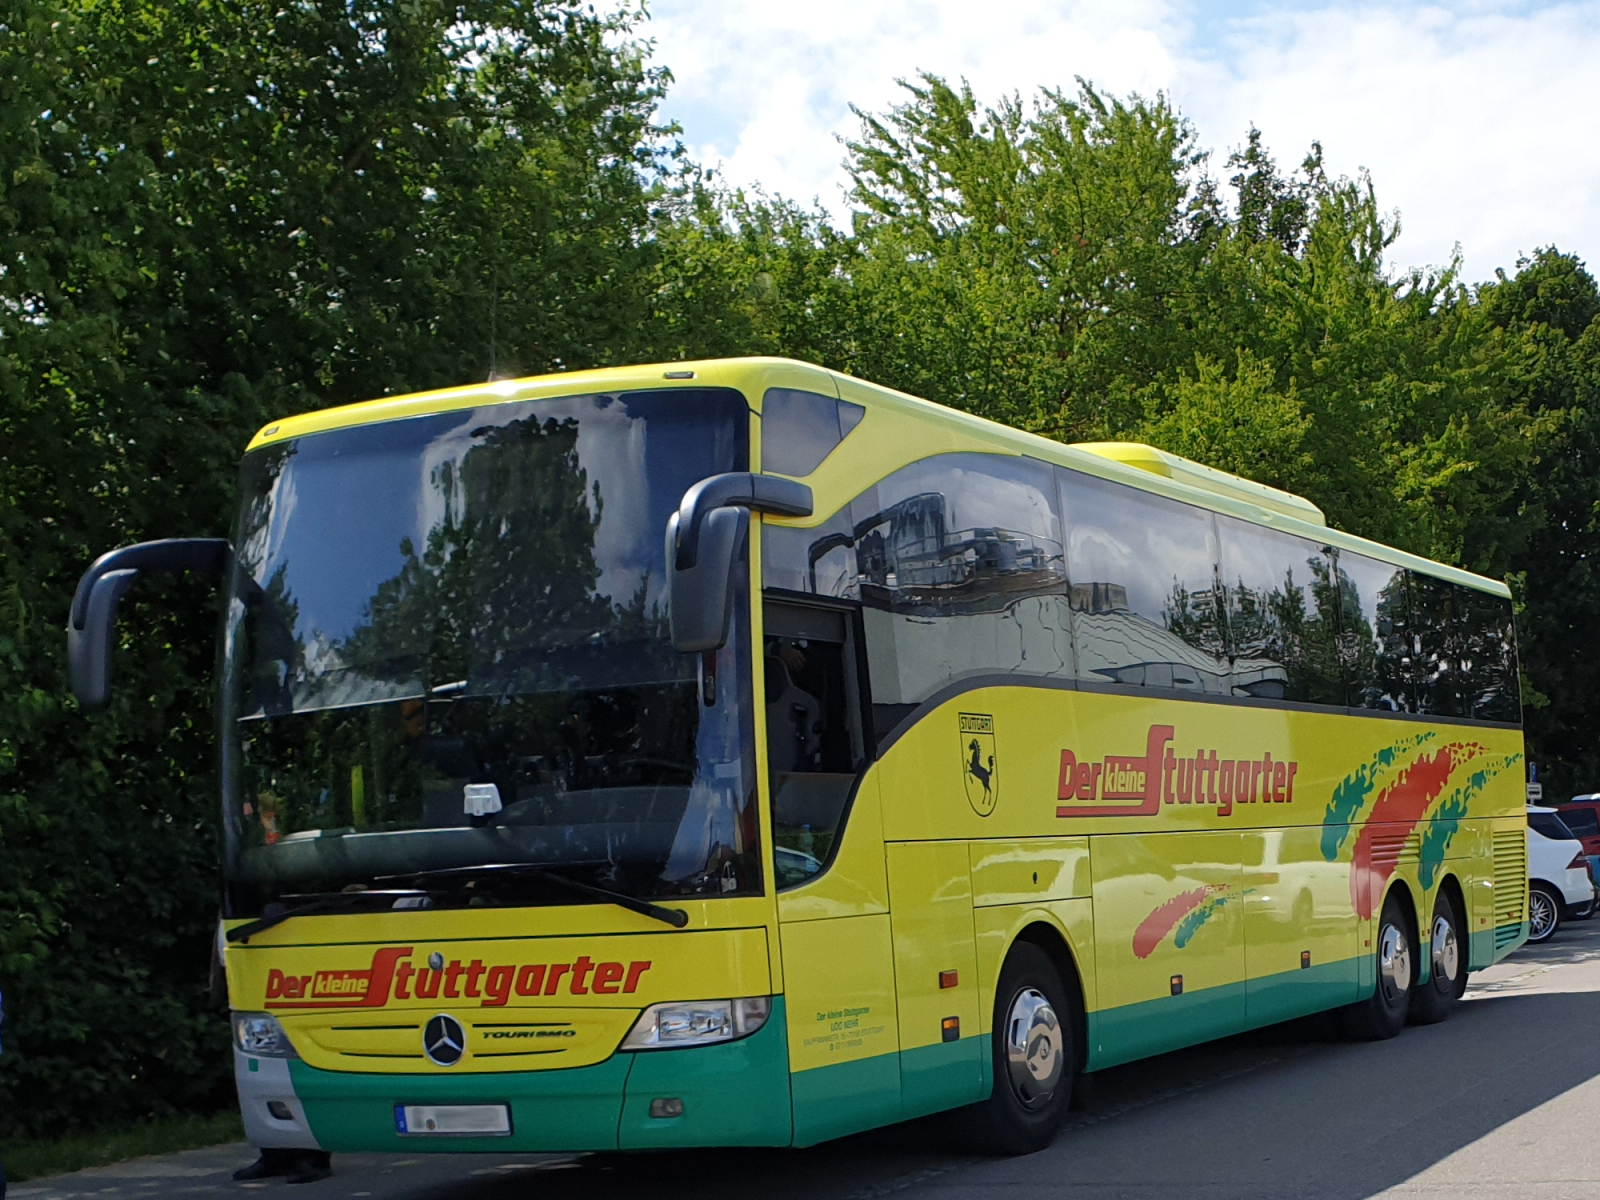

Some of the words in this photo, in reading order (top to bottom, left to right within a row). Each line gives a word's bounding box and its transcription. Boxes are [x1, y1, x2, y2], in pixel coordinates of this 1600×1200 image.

[1057, 749, 1102, 800] Der
[1105, 763, 1145, 793] kleine
[1144, 724, 1298, 816] Stuttgarter
[265, 969, 312, 998] Der
[314, 974, 369, 994] kleine
[366, 947, 652, 1007] Stuttgarter
[483, 1030, 576, 1039] TOURISMO
